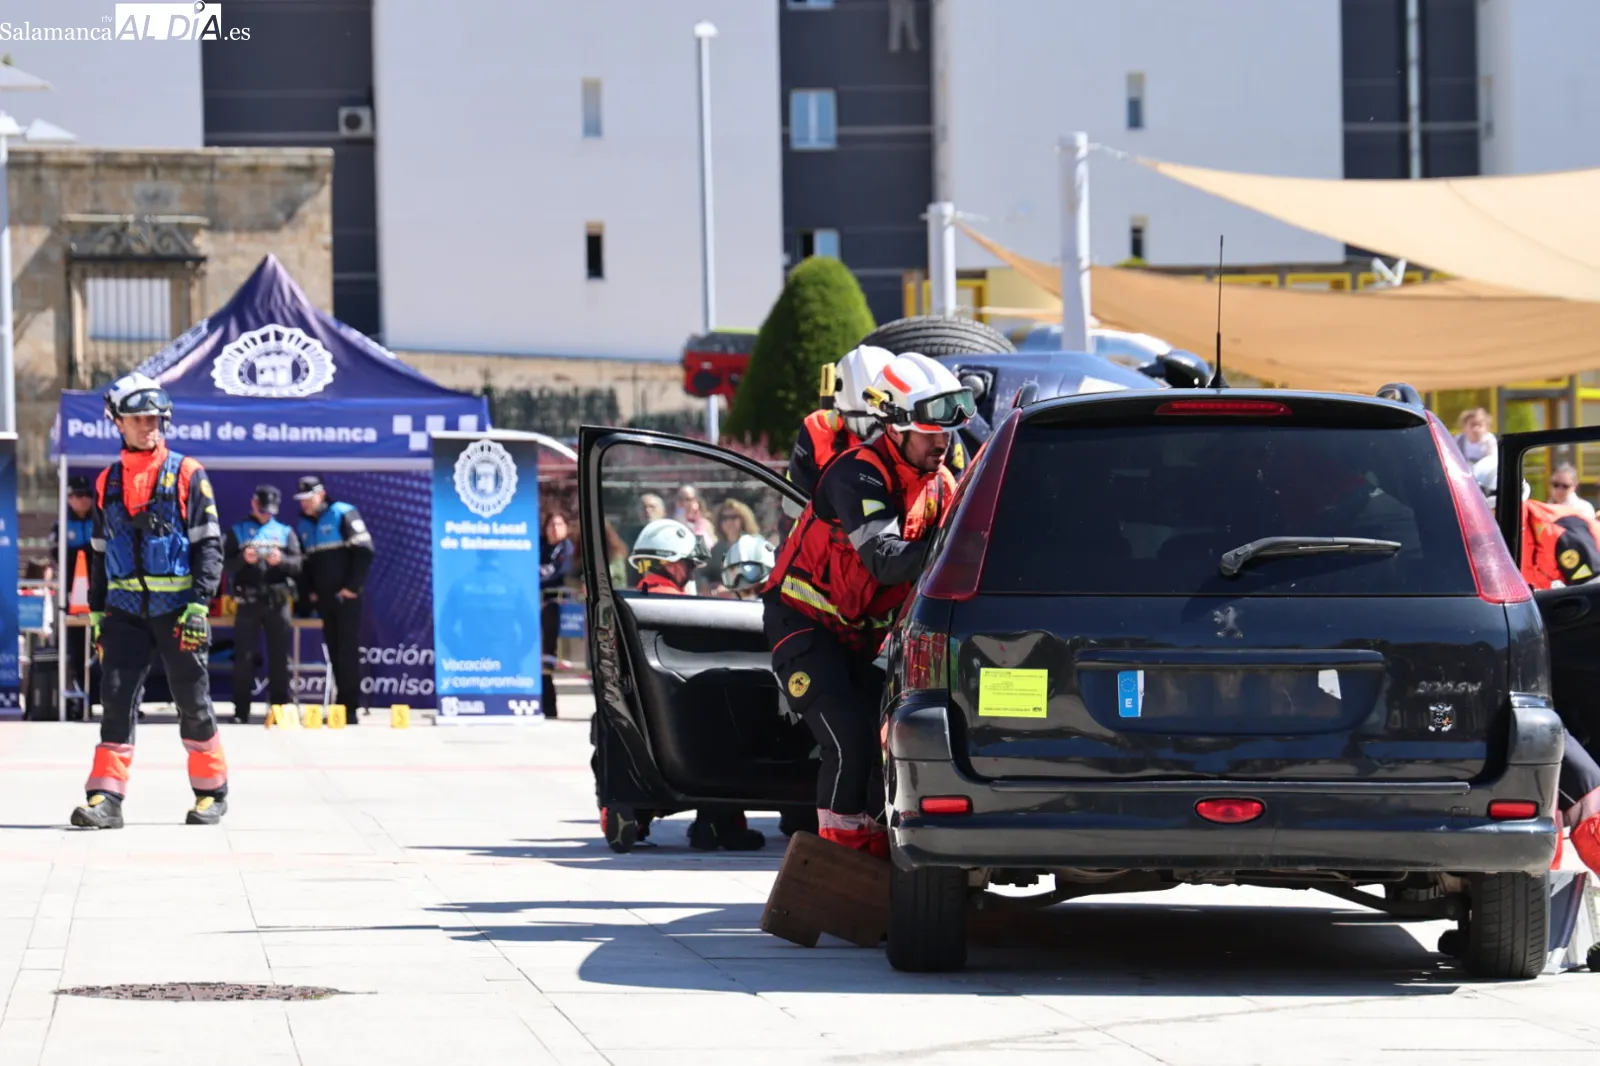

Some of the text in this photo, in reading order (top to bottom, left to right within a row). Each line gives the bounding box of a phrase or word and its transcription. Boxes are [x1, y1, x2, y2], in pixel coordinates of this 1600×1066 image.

[168, 420, 211, 441] ocal
[217, 421, 247, 441] de
[252, 422, 378, 443] Salamanca
[1125, 698, 1133, 708] E
